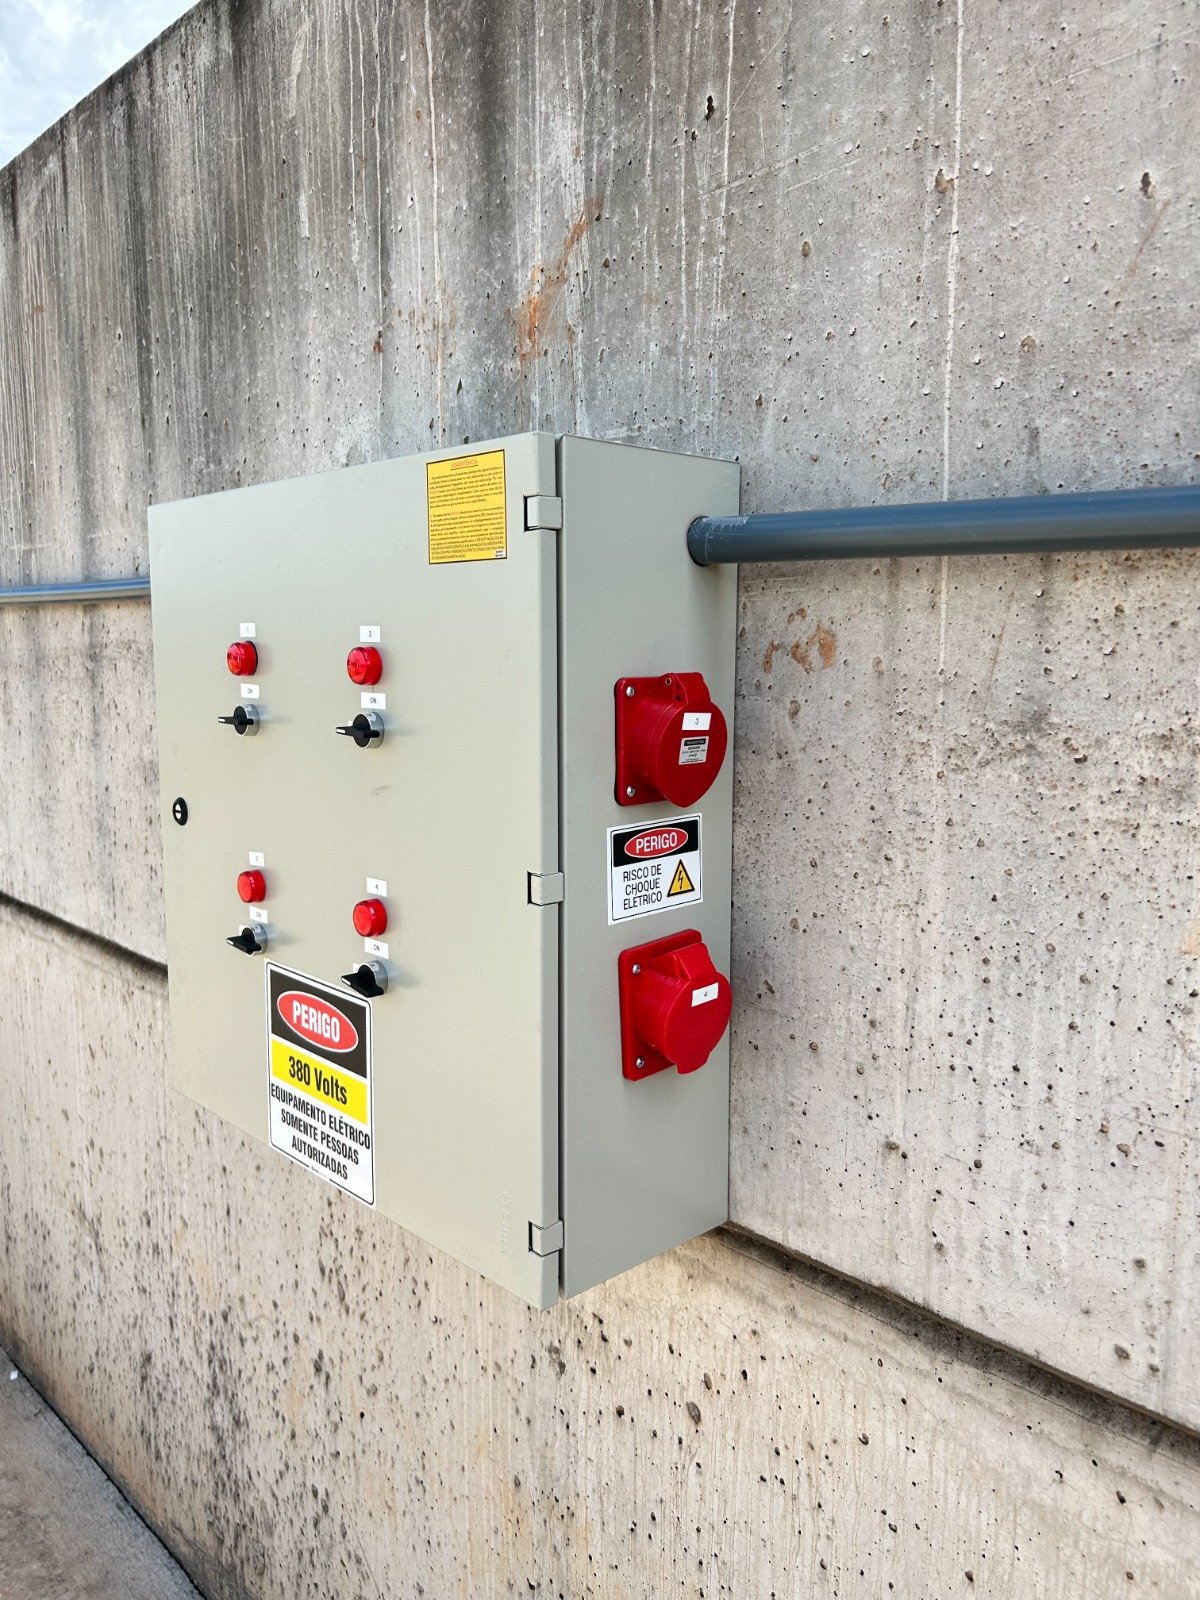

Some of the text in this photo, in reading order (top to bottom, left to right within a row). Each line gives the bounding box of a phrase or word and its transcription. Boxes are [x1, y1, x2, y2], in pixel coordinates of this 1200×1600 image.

[635, 831, 678, 854] PERIGO
[623, 863, 662, 882] RISCO DE
[625, 878, 660, 896] CHOQUE
[623, 891, 663, 911] ELETRICO
[292, 999, 341, 1043] PERIGO
[288, 1055, 348, 1105] 380 Volts
[270, 1083, 371, 1150] EQUIPAMENTO ELÉTRICO
[281, 1108, 360, 1166] SOMENTE PESSOAS
[291, 1135, 348, 1180] AUTORIZADAS
